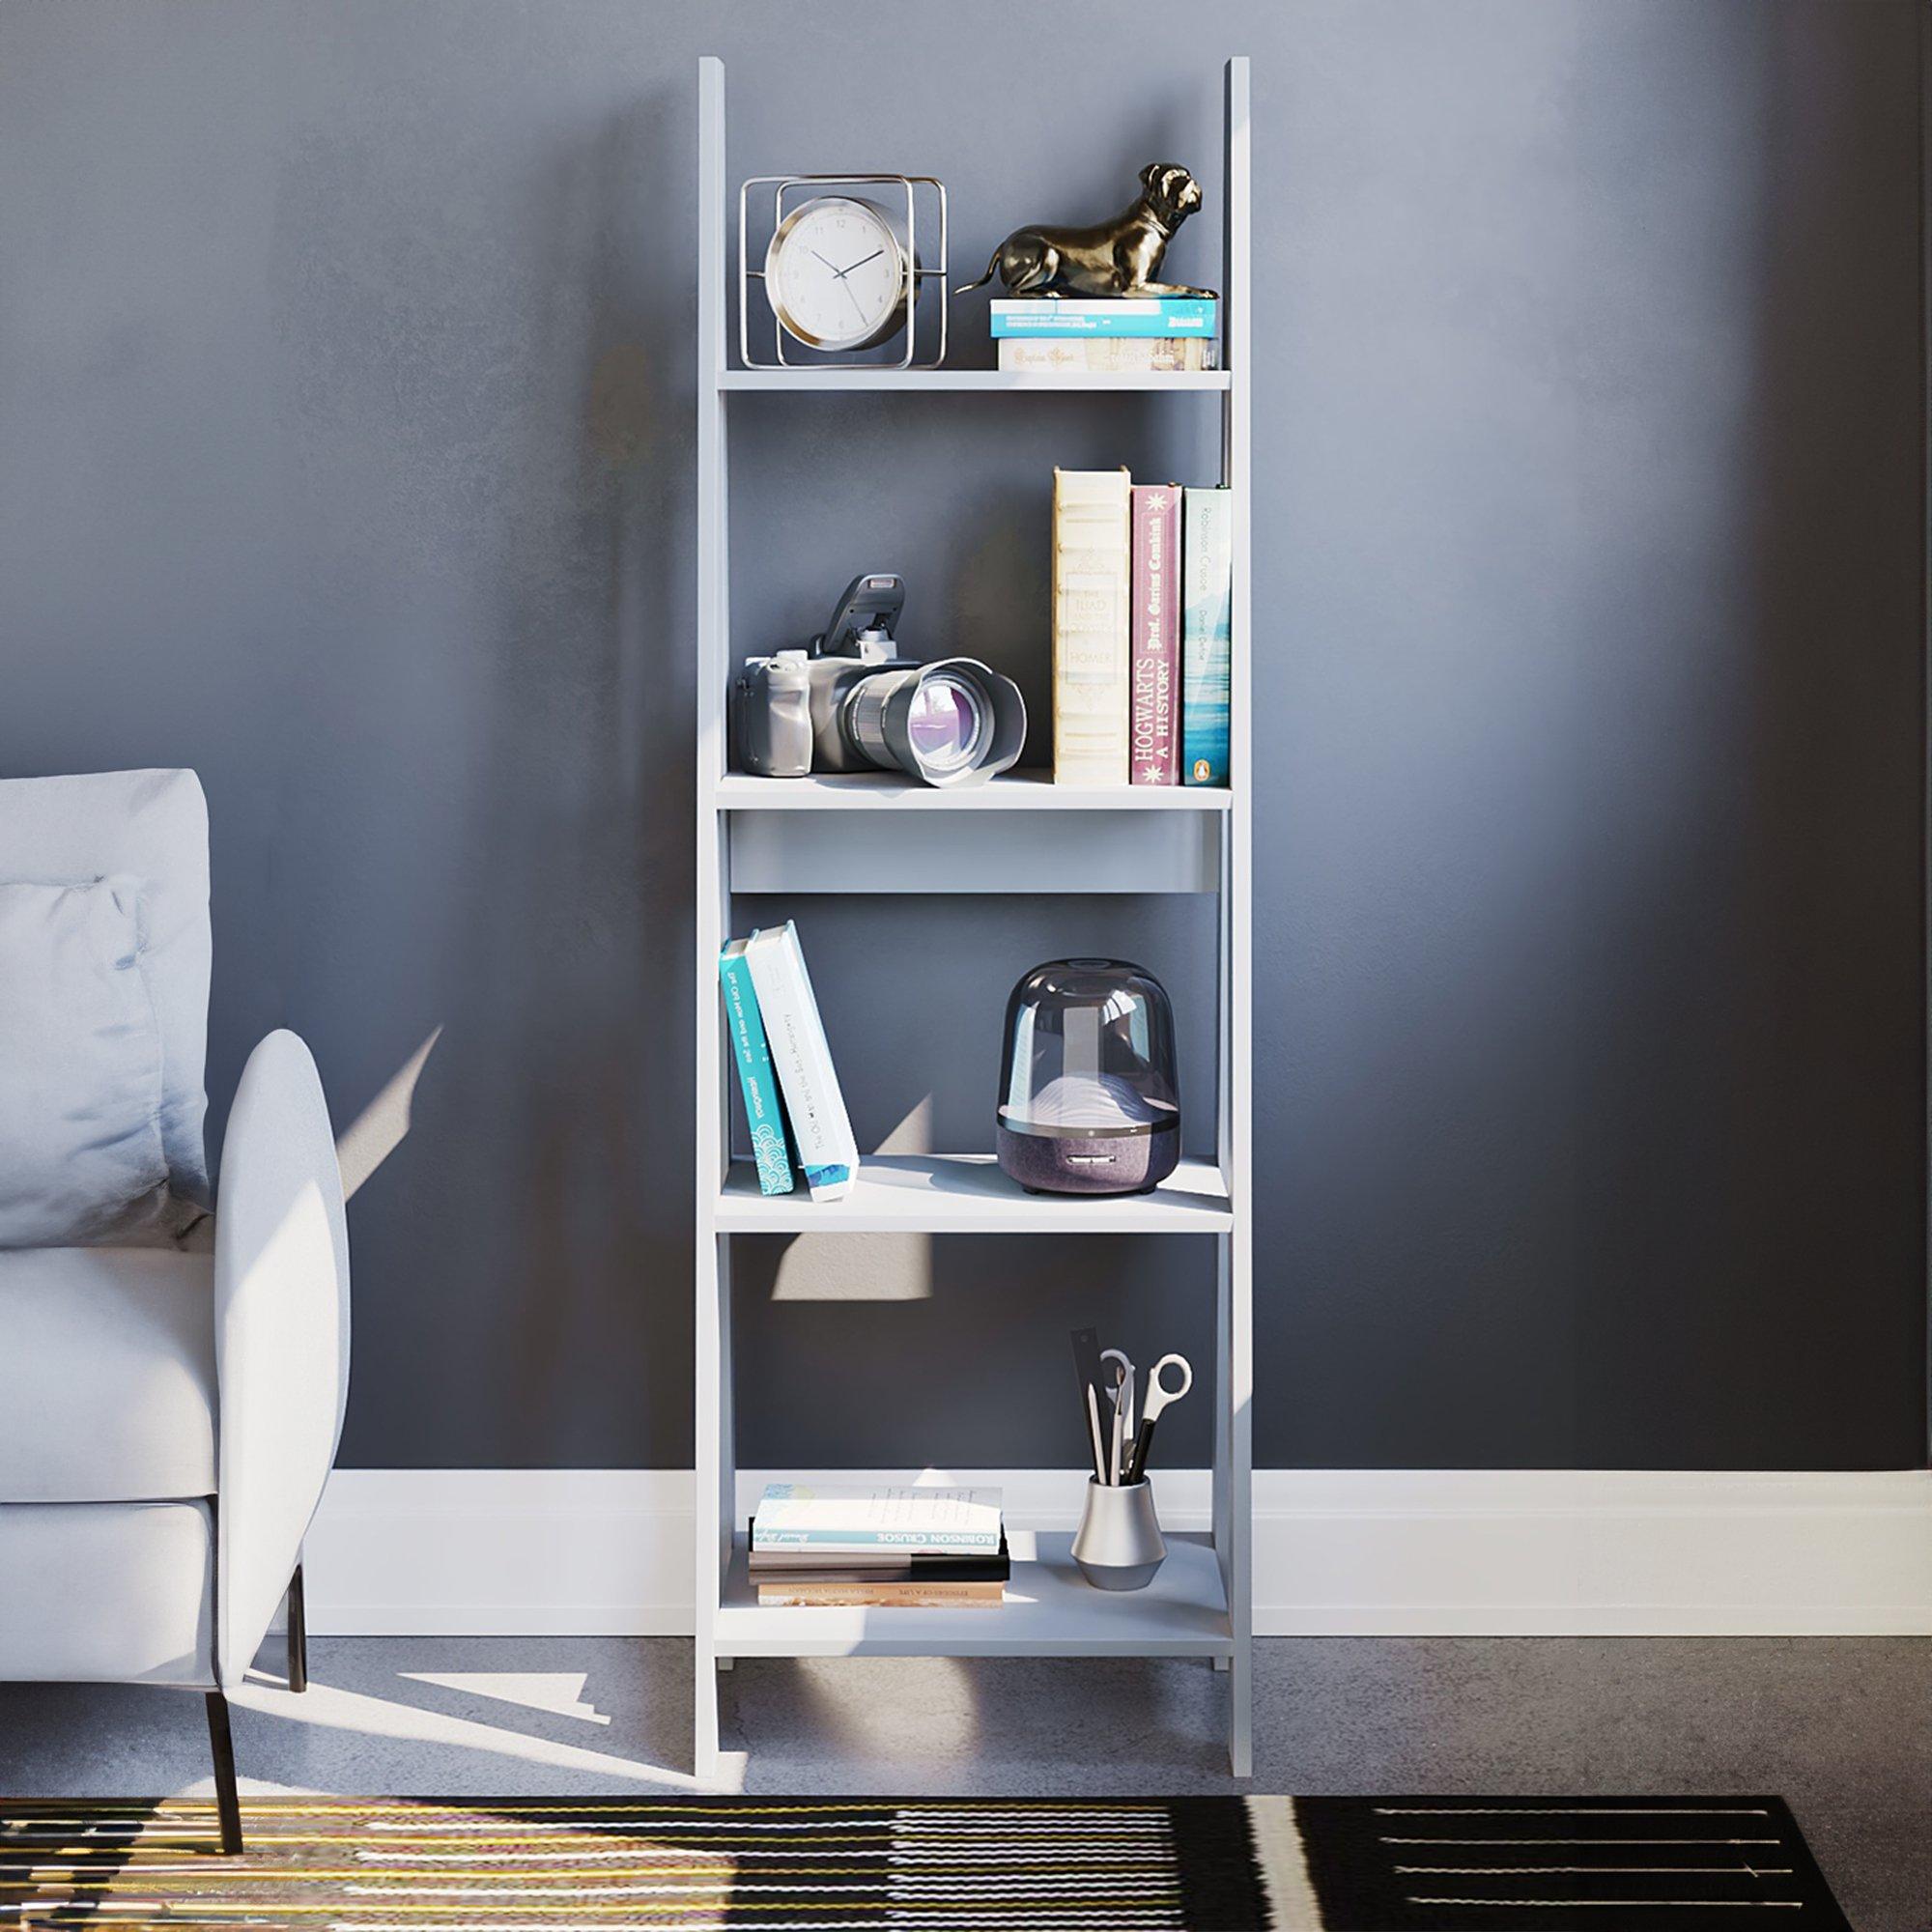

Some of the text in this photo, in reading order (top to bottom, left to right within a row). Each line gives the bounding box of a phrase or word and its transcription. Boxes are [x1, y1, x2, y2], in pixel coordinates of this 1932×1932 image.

[837, 219, 846, 229] 12
[1200, 508, 1211, 591] Robinson Crusoe
[1135, 658, 1154, 761] HOGWARTS
[1156, 659, 1170, 758] A HISTORY
[876, 1533, 995, 1546] ROBINSON CRUSOE
